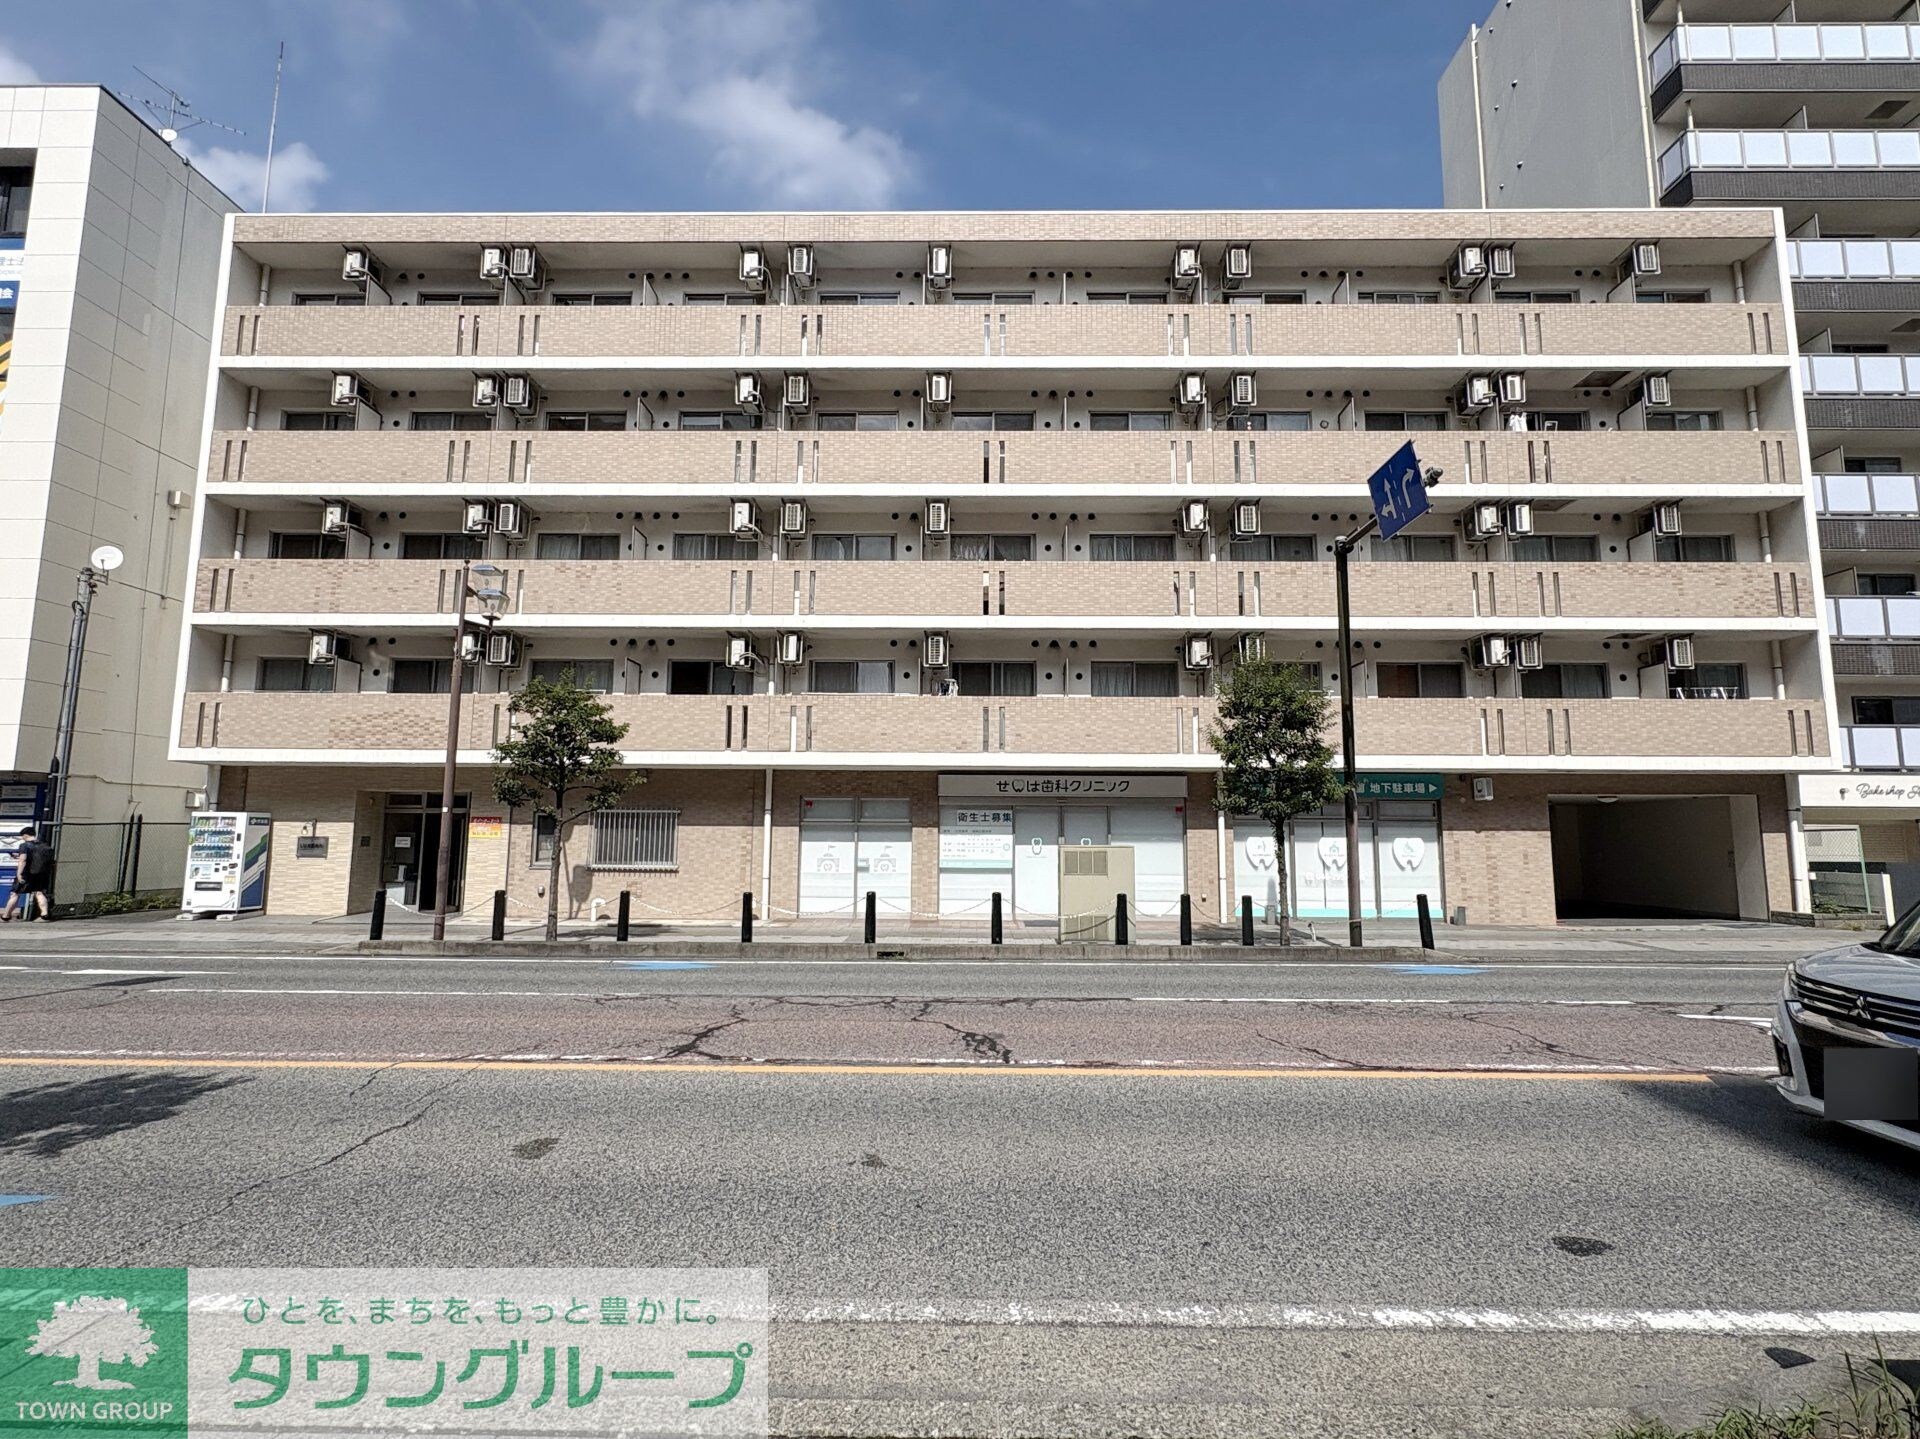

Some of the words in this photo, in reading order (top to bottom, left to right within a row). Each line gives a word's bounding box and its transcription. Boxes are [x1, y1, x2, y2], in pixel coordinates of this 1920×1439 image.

[1369, 782, 1425, 794] 地下駐車場
[1885, 785, 1905, 800] shop
[957, 811, 1012, 823] 衛生士募集
